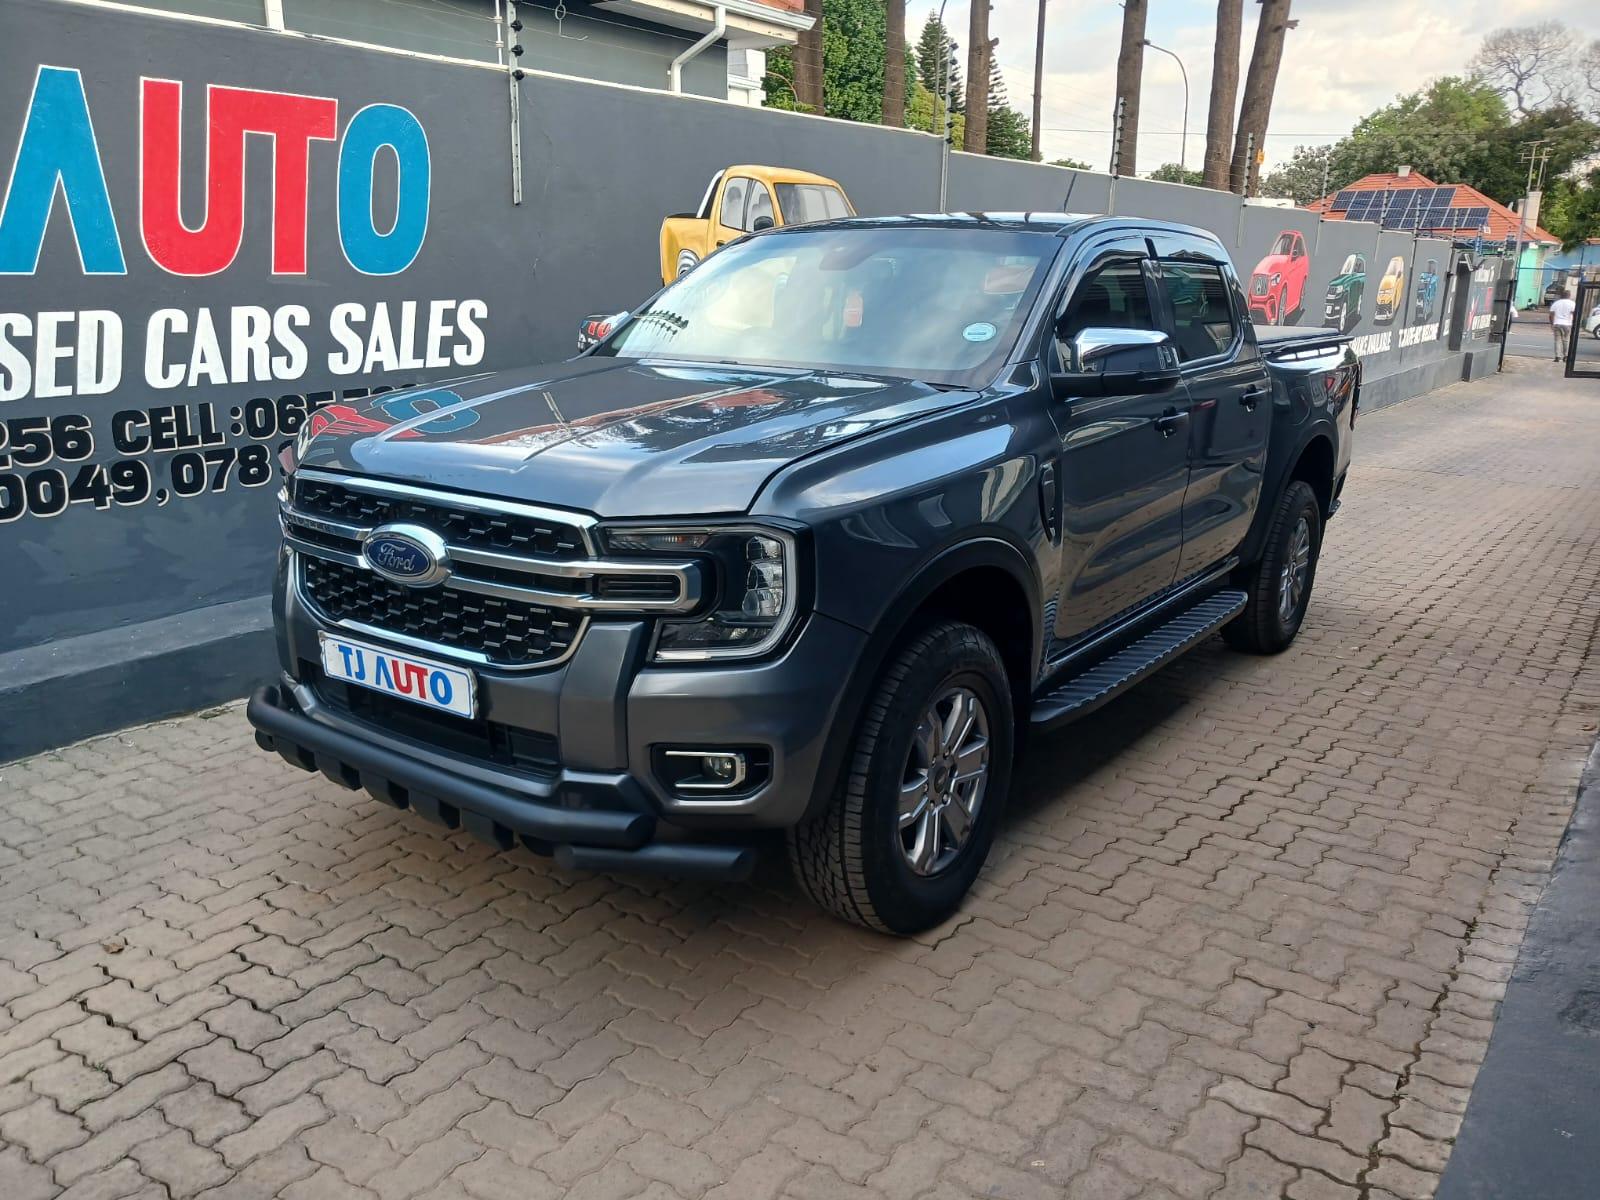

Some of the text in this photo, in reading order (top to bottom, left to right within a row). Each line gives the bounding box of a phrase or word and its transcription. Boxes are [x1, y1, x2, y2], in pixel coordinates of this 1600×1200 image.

[0, 64, 432, 277] AUTO
[144, 304, 312, 389] CARS
[327, 298, 488, 376] SALES
[377, 541, 416, 573] Ford
[337, 644, 453, 705] TJ AUTO
